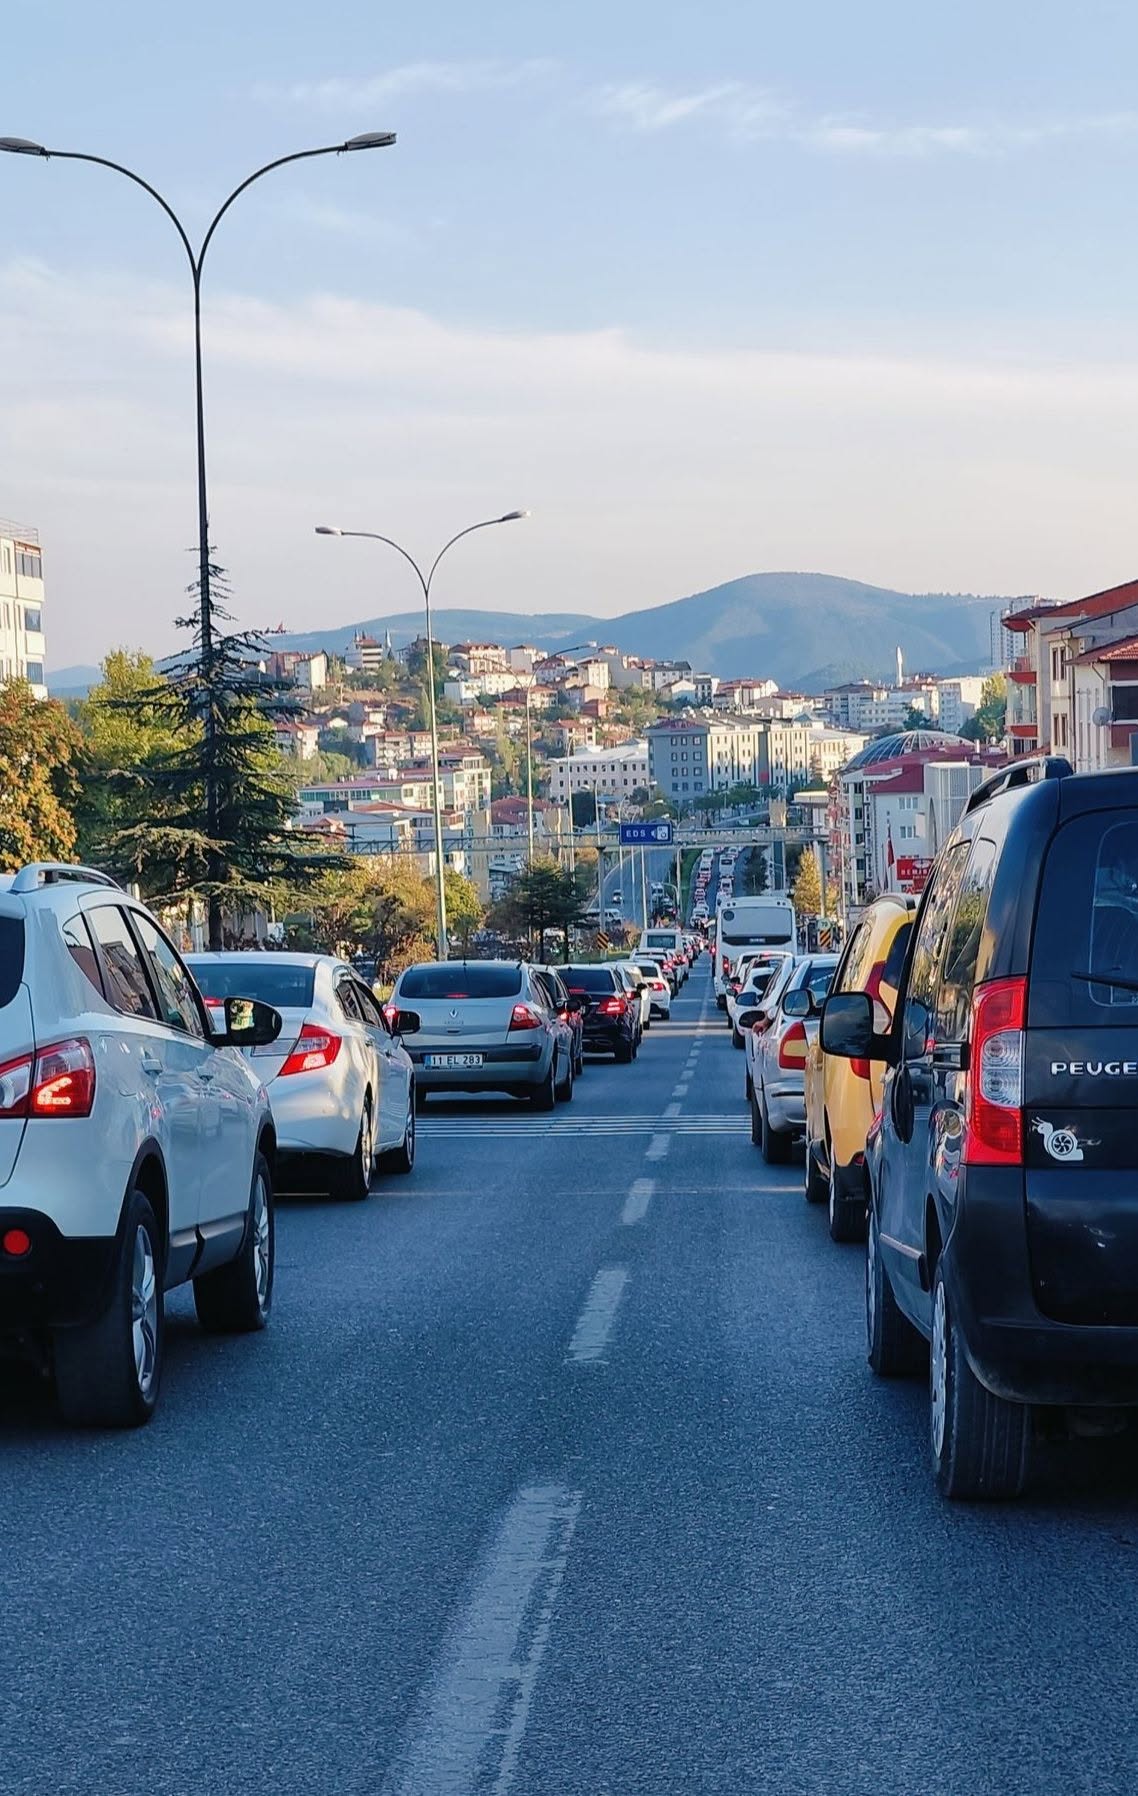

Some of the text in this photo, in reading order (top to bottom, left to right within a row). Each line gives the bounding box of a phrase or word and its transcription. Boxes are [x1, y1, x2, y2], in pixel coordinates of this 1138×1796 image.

[626, 830, 646, 838] EDS
[433, 1055, 480, 1065] 11 EL 283
[1051, 1062, 1137, 1076] PEUGE
